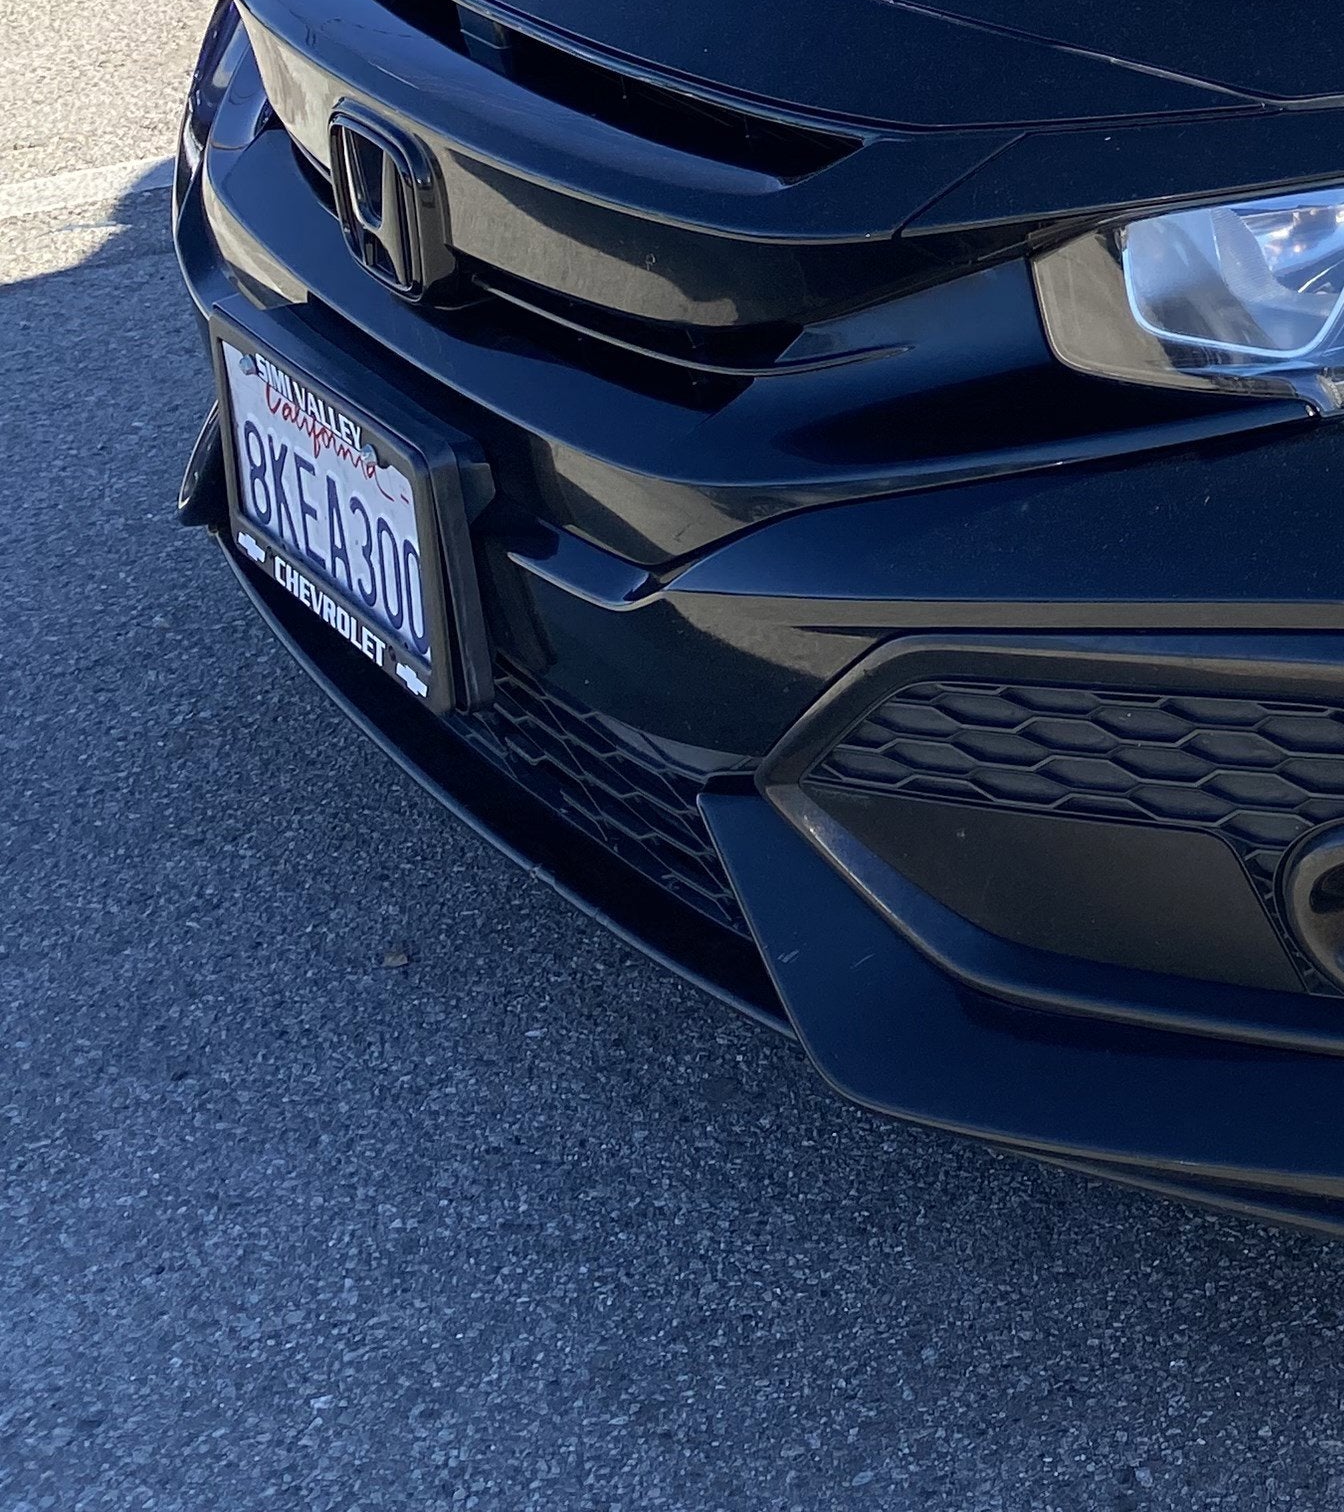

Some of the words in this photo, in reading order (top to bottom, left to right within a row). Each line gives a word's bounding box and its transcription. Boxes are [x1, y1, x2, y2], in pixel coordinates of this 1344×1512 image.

[255, 353, 296, 409] SIMI
[292, 381, 362, 453] VALLEY
[243, 419, 430, 656] 8KEA300
[273, 555, 386, 667] CHEVROLET
